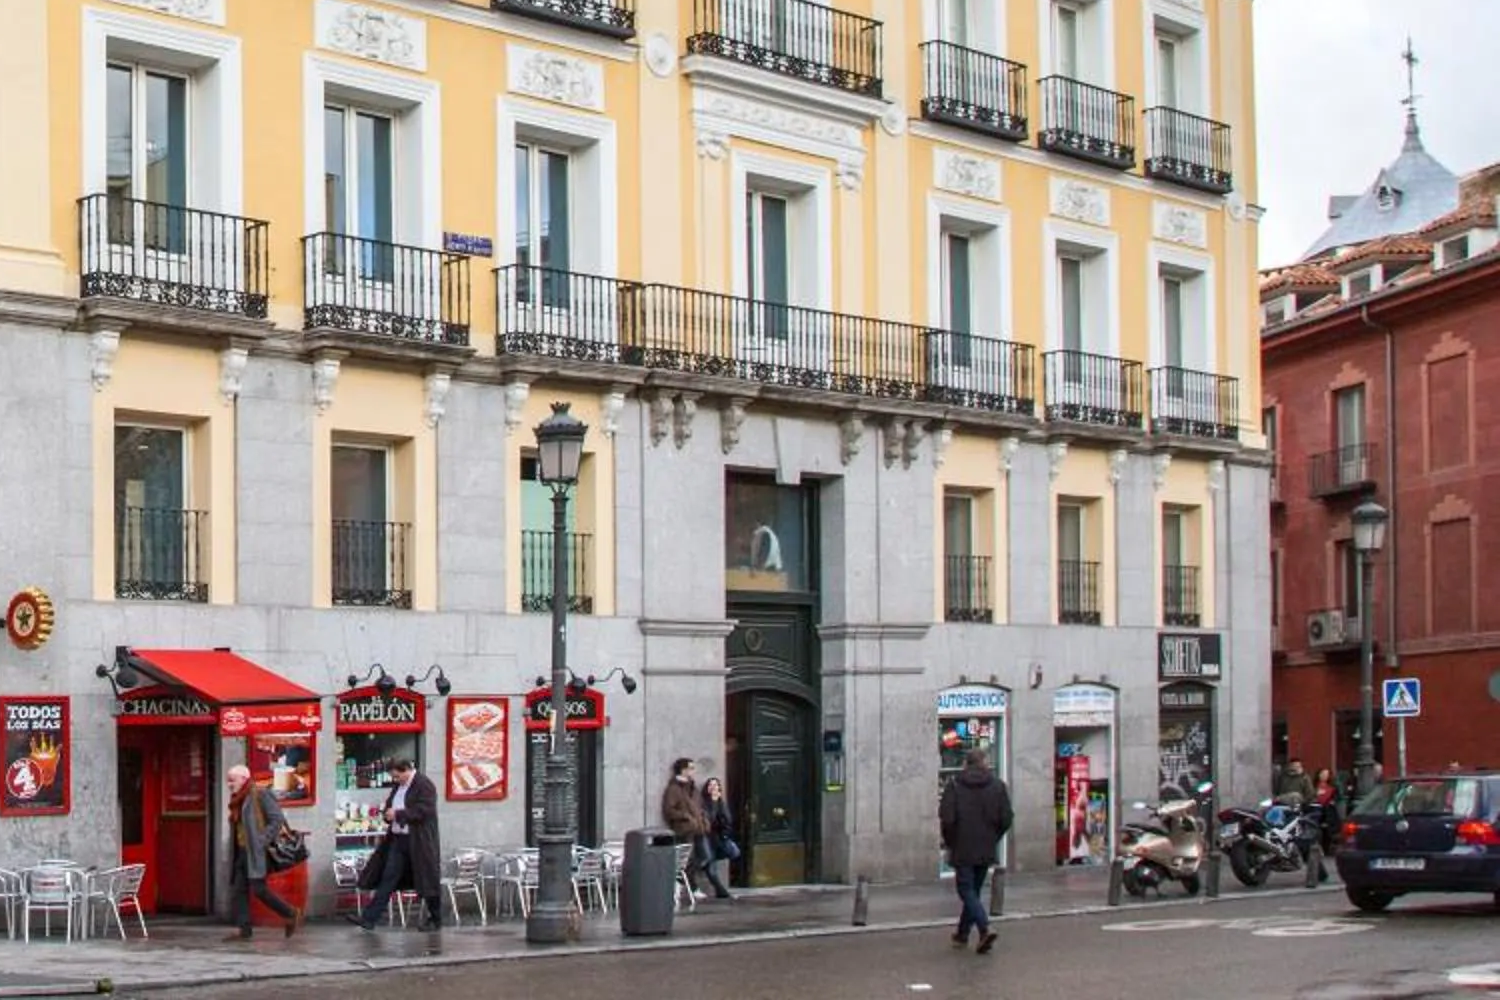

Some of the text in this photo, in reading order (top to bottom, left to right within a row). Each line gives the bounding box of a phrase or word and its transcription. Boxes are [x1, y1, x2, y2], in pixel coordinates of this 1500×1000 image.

[7, 705, 61, 719] TODOS
[121, 699, 211, 715] CHACINAS
[340, 697, 415, 721] PAPELÓN
[7, 720, 29, 730] LOS
